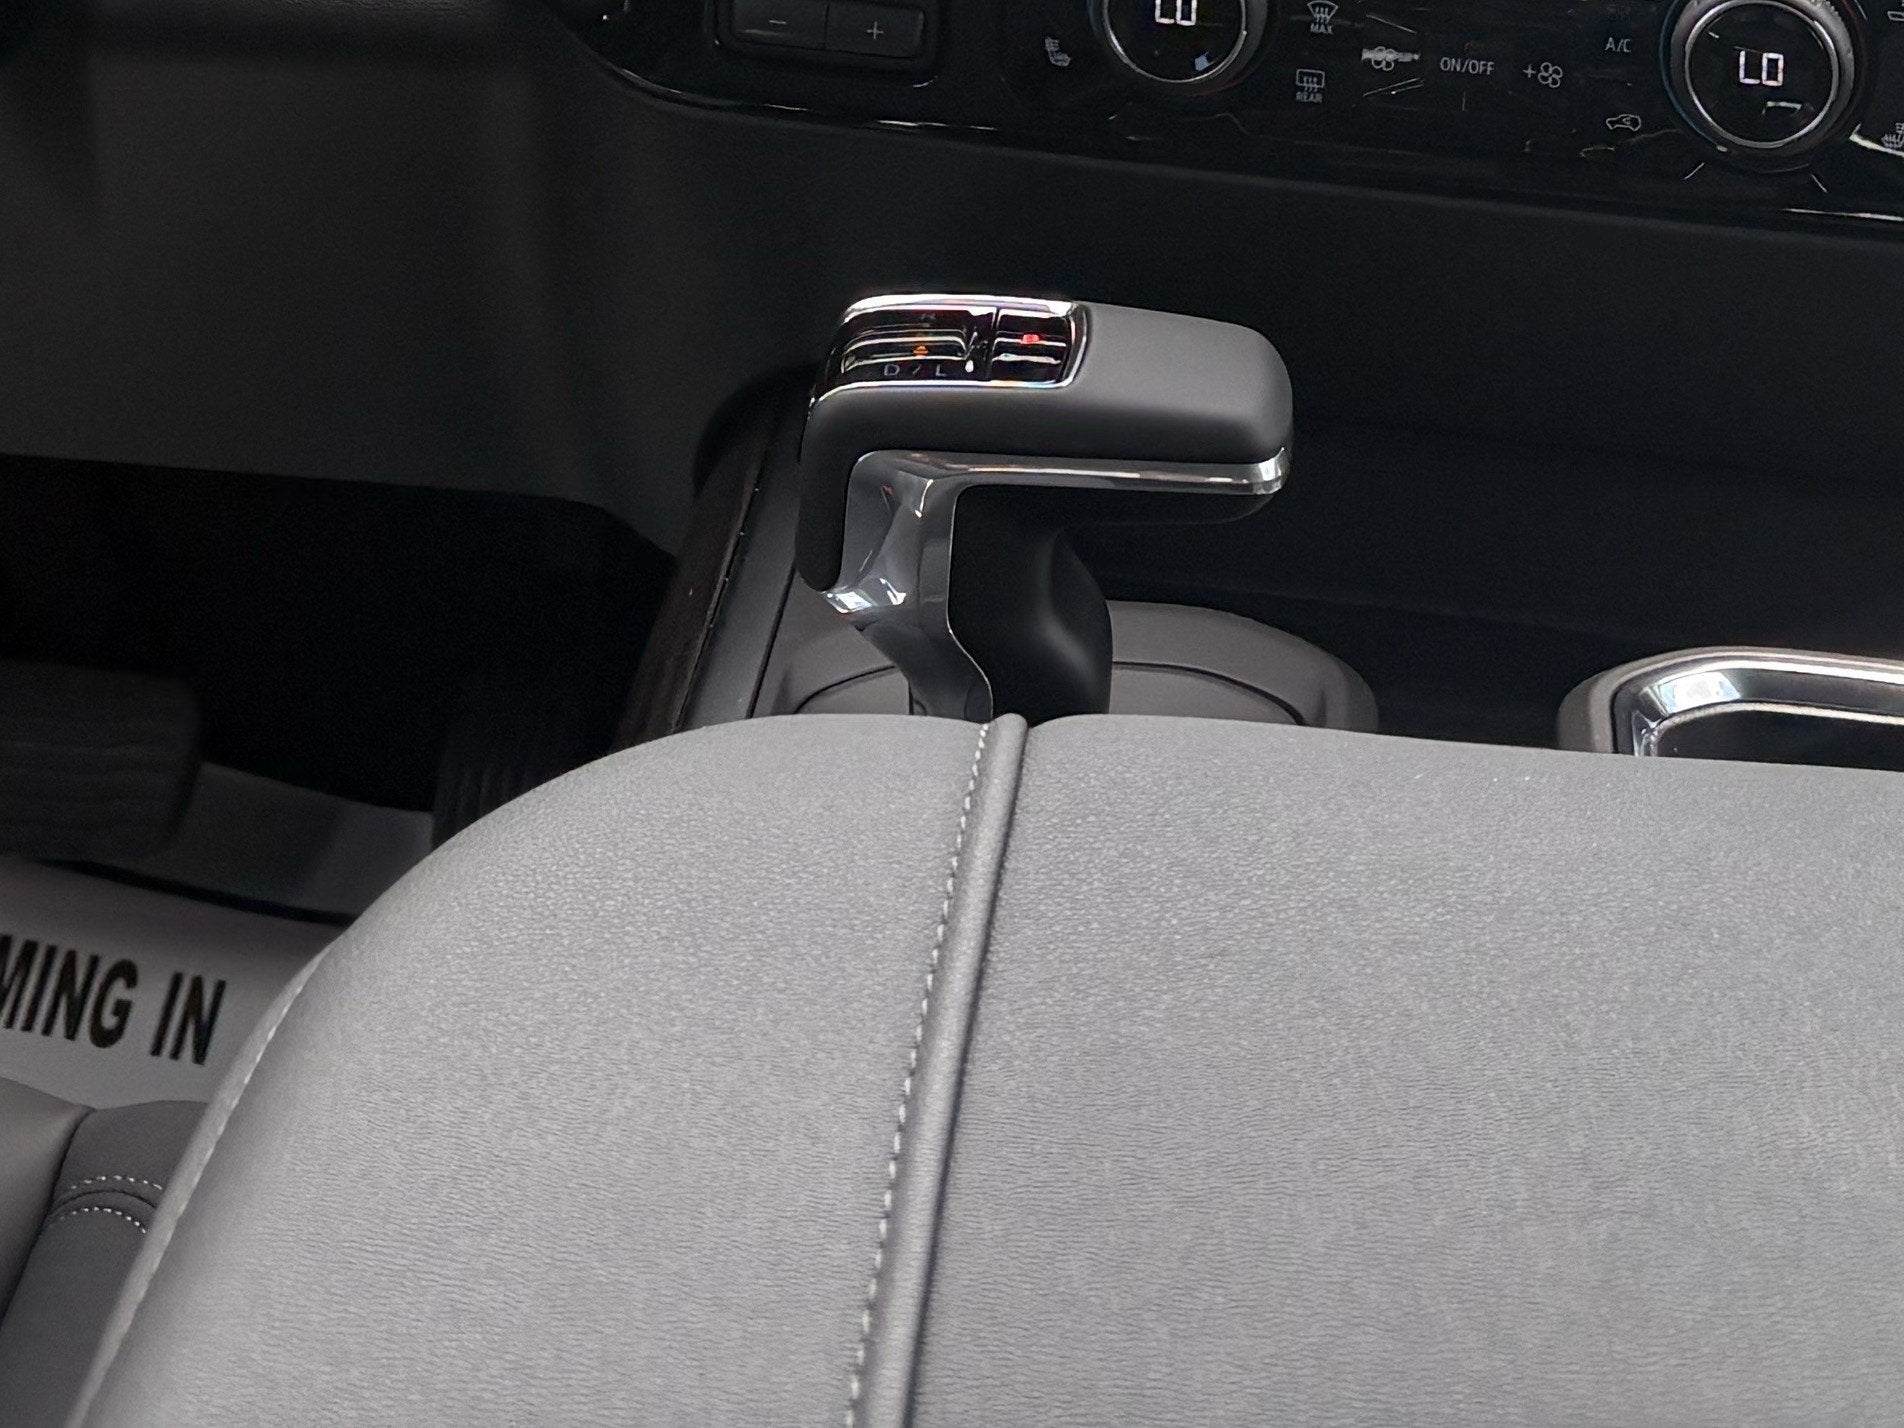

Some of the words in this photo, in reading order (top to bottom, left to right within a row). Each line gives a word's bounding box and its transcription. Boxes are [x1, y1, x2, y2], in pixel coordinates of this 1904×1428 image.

[1310, 24, 1333, 35] MAX
[1605, 36, 1632, 53] A/C
[1440, 57, 1495, 77] ON/OFF
[1296, 91, 1323, 104] REAR
[148, 970, 228, 1066] IN
